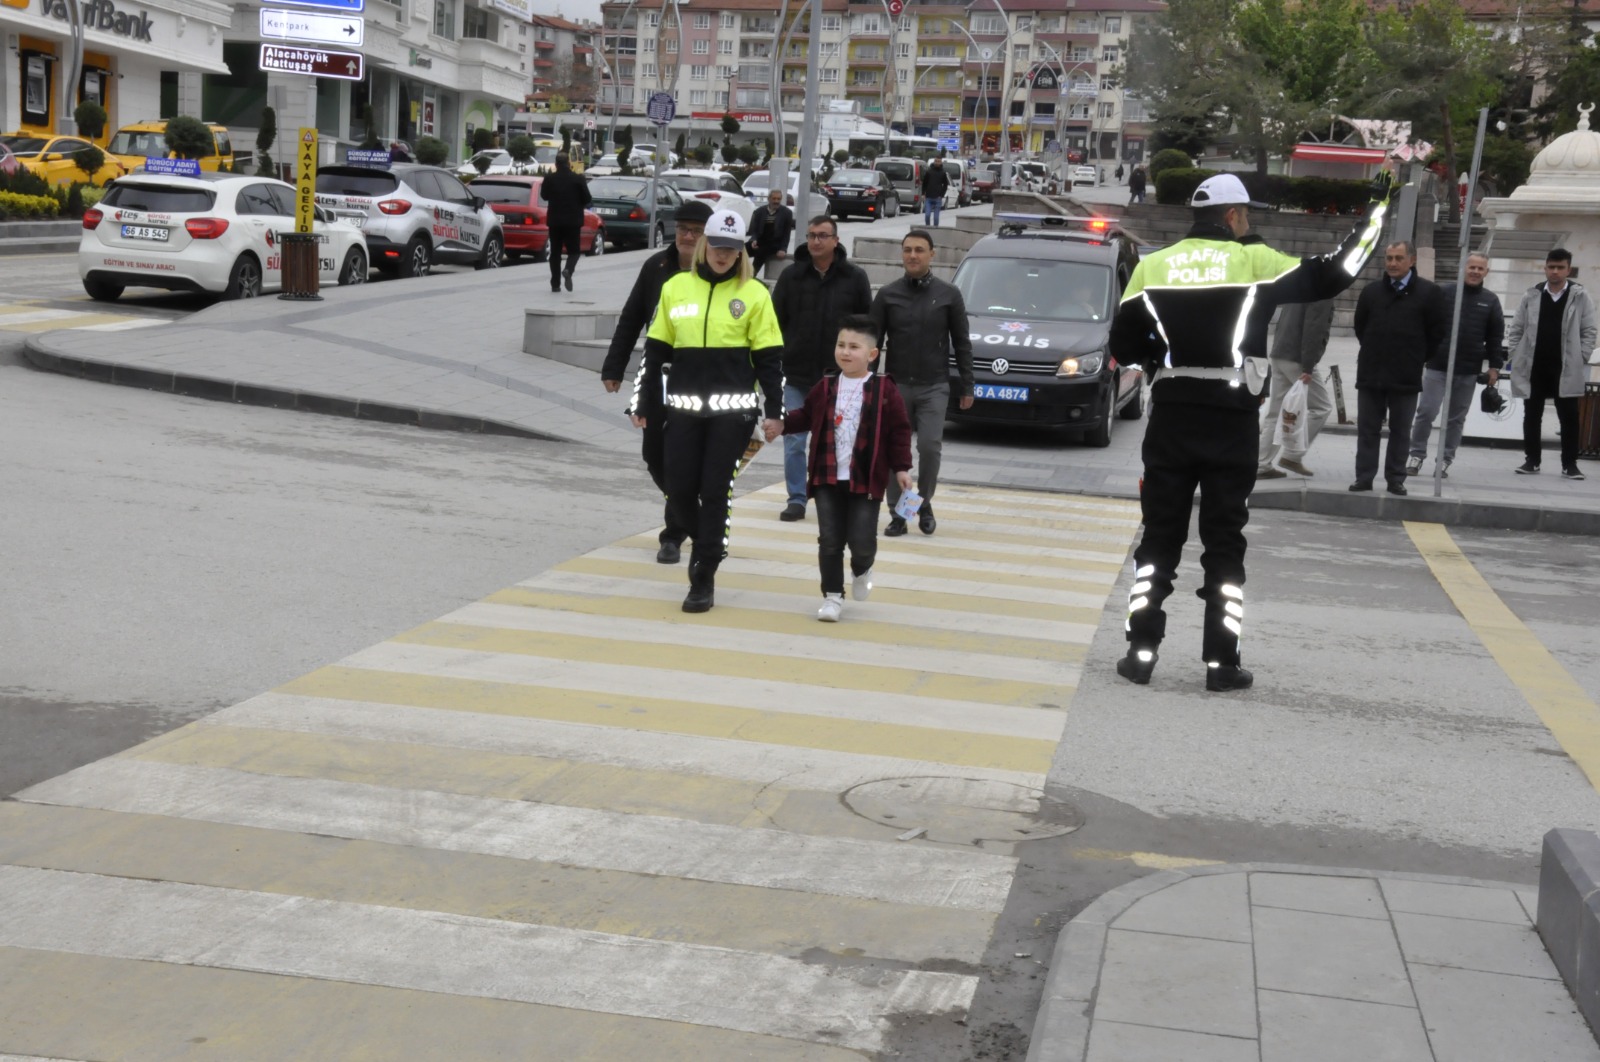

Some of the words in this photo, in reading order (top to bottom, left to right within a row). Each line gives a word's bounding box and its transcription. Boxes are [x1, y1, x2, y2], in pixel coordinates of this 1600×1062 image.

[267, 19, 309, 31] Kentpark
[266, 48, 329, 63] Alacahöyük
[265, 57, 313, 72] Hattuşaş
[147, 159, 175, 167] SÜRÜCÜ
[176, 161, 196, 169] ADAYI
[302, 143, 313, 180] YAYA
[125, 226, 135, 235] 66
[138, 227, 149, 237] AS
[151, 228, 168, 239] 545
[459, 227, 480, 245] kursu
[103, 258, 125, 267] EĞİTİM
[135, 261, 155, 270] SINAV
[156, 262, 176, 271] ARACI
[985, 387, 996, 399] A
[998, 388, 1028, 400] 4874
